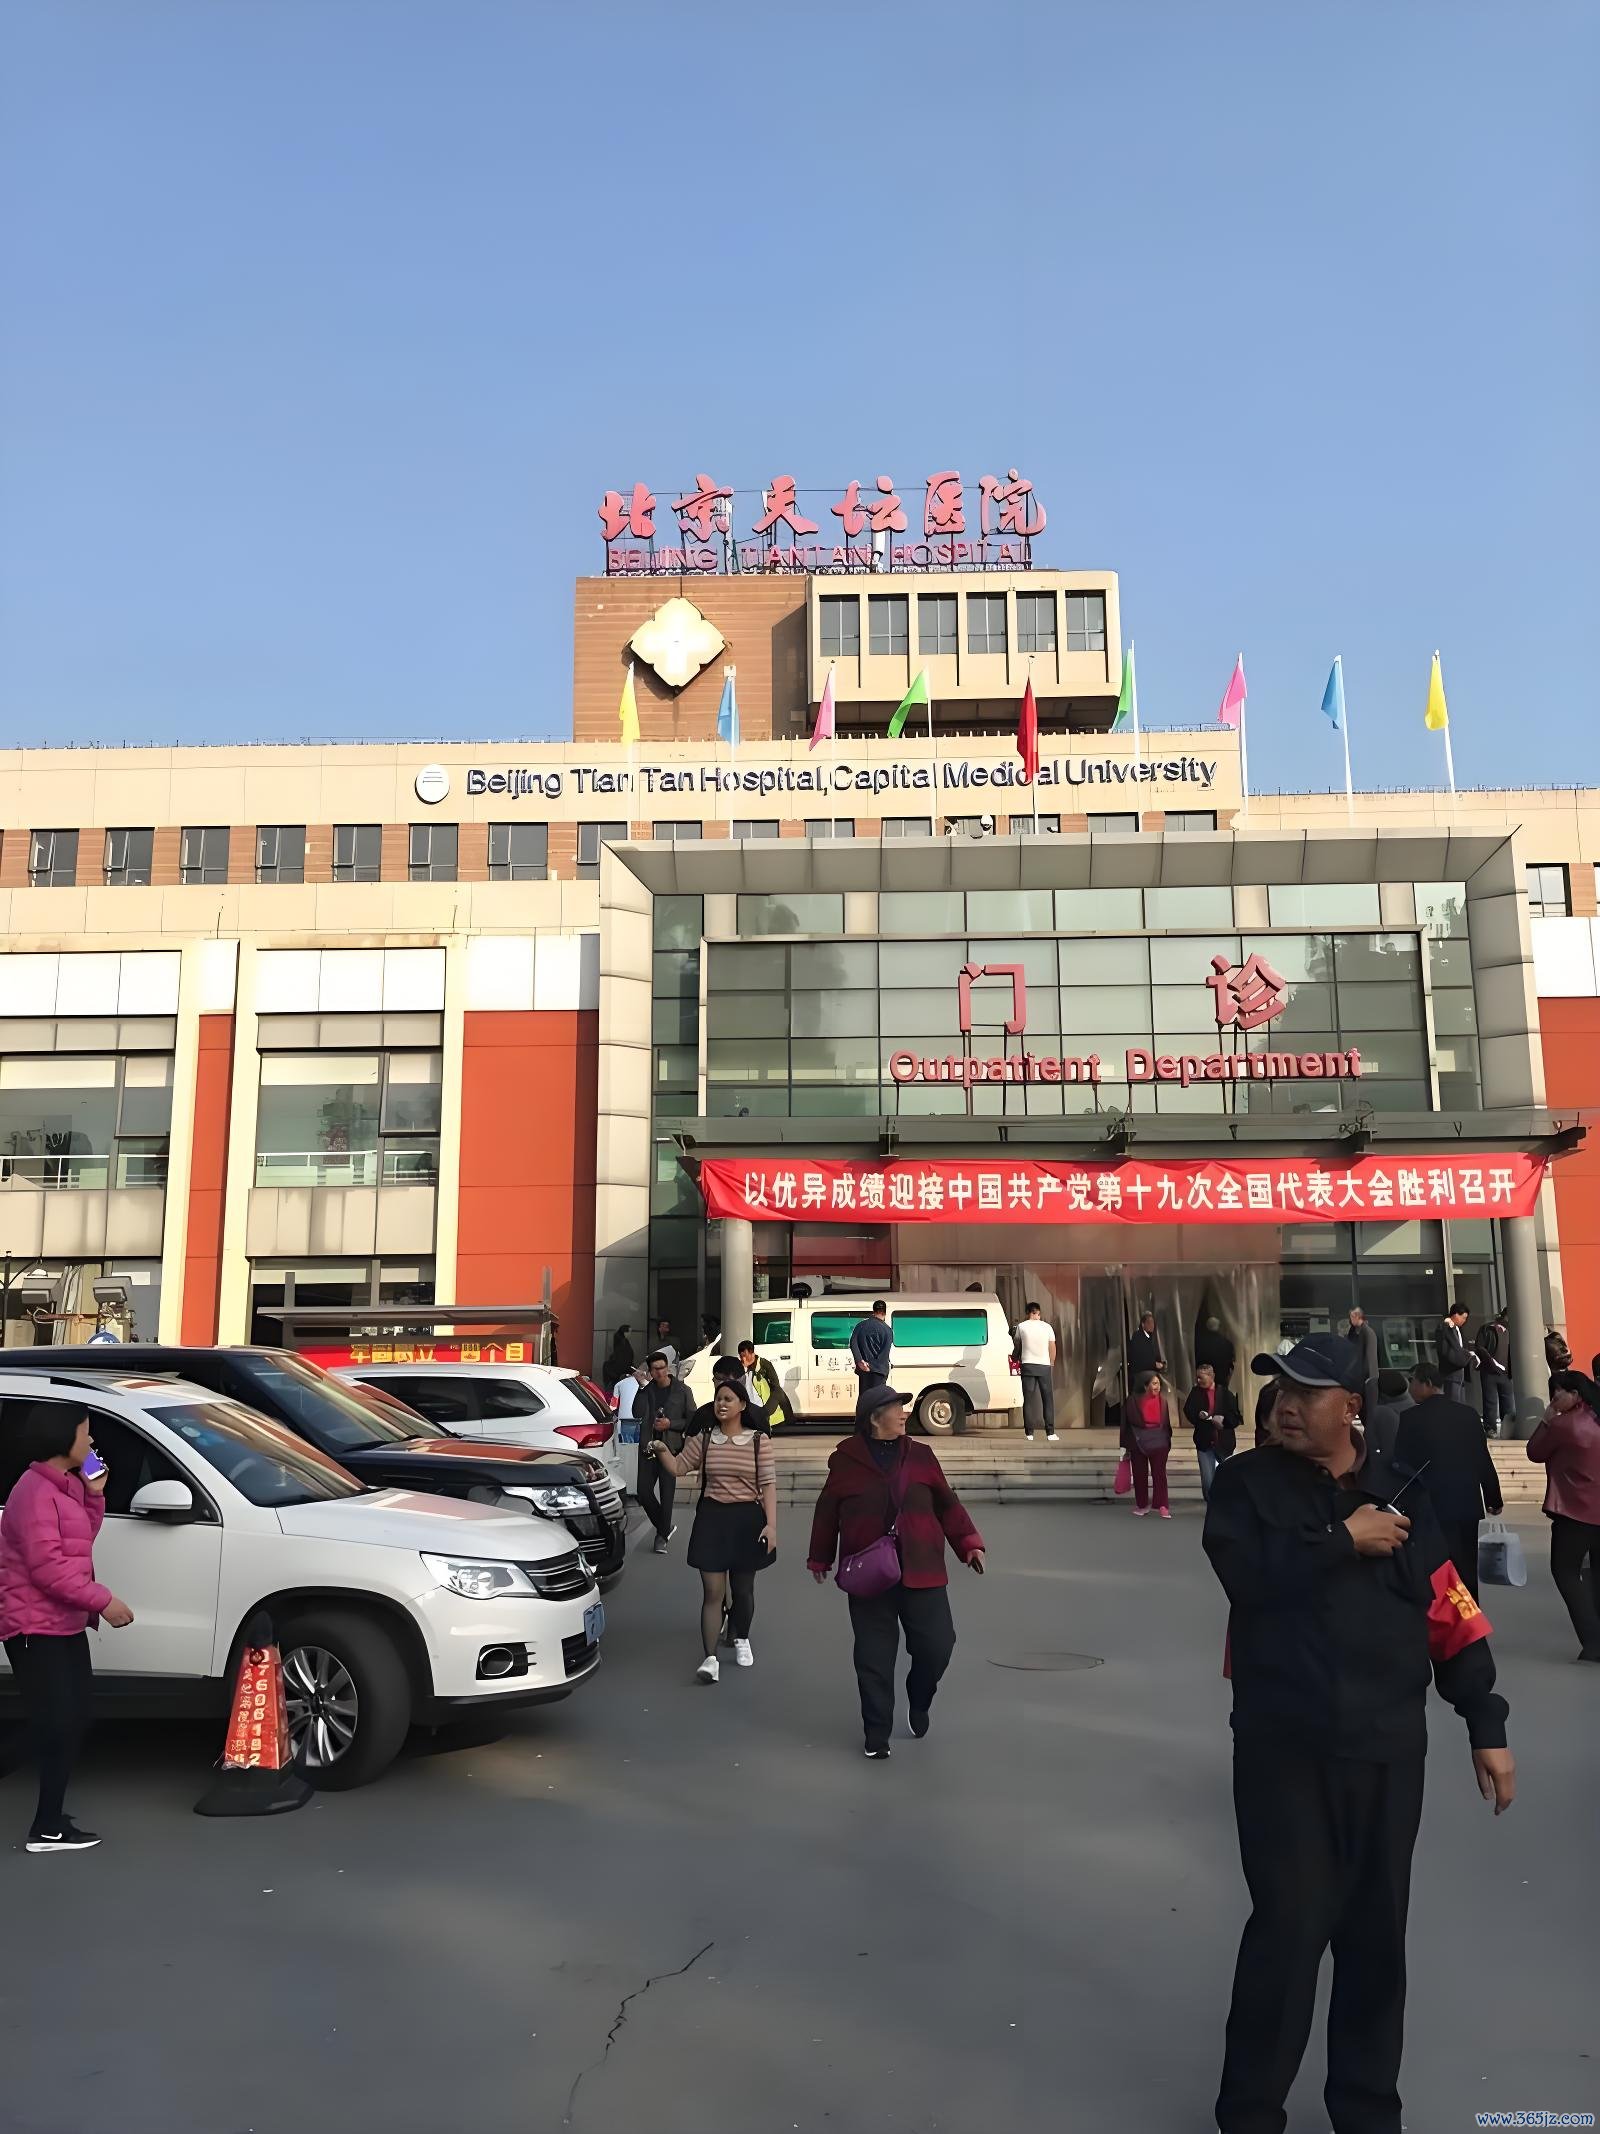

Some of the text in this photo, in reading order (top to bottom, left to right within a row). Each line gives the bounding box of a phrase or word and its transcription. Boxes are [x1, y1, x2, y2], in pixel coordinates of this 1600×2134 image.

[597, 467, 1047, 543] 北京天坛医院
[466, 768, 562, 800] Beijing
[570, 768, 633, 793] Tian
[640, 766, 694, 792] Tan
[943, 759, 1060, 788] Medical
[1065, 756, 1217, 788] University
[957, 953, 1288, 1034] 门诊
[889, 1047, 1362, 1089] Outpatient Department
[743, 1167, 1517, 1212] 以优异成绩迎接中国共产党第十九次全国代表大会胜利召开
